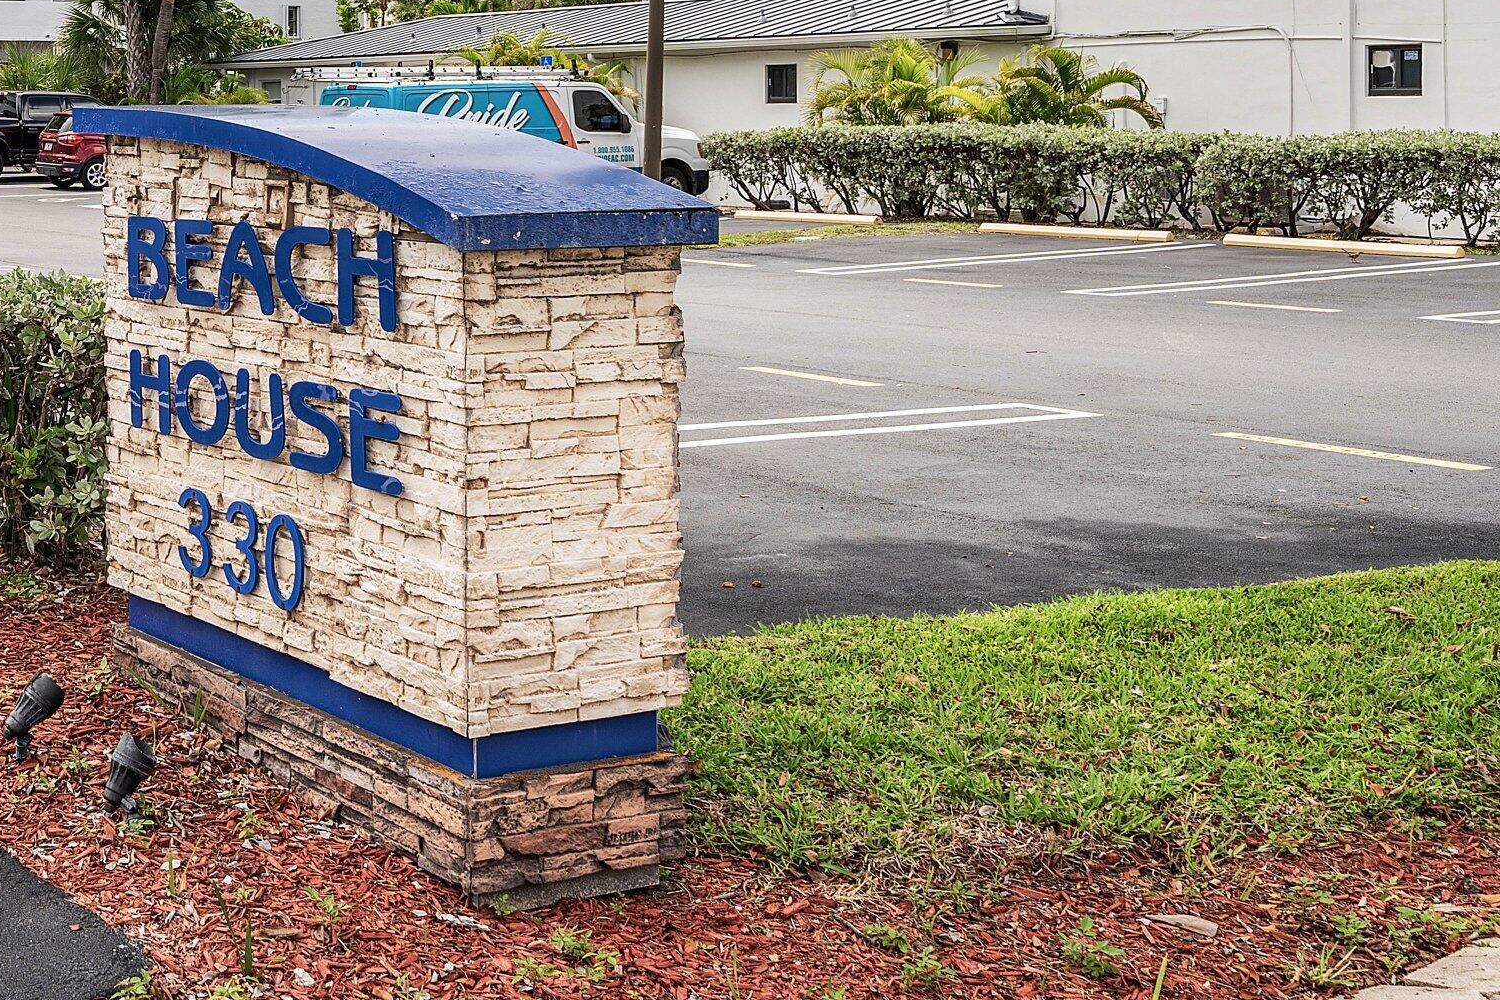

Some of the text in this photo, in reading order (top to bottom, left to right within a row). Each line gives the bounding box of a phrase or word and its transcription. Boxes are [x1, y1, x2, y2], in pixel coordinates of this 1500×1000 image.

[127, 216, 398, 333] BEACH
[129, 348, 404, 497] HOUSE
[177, 487, 306, 612] 330
